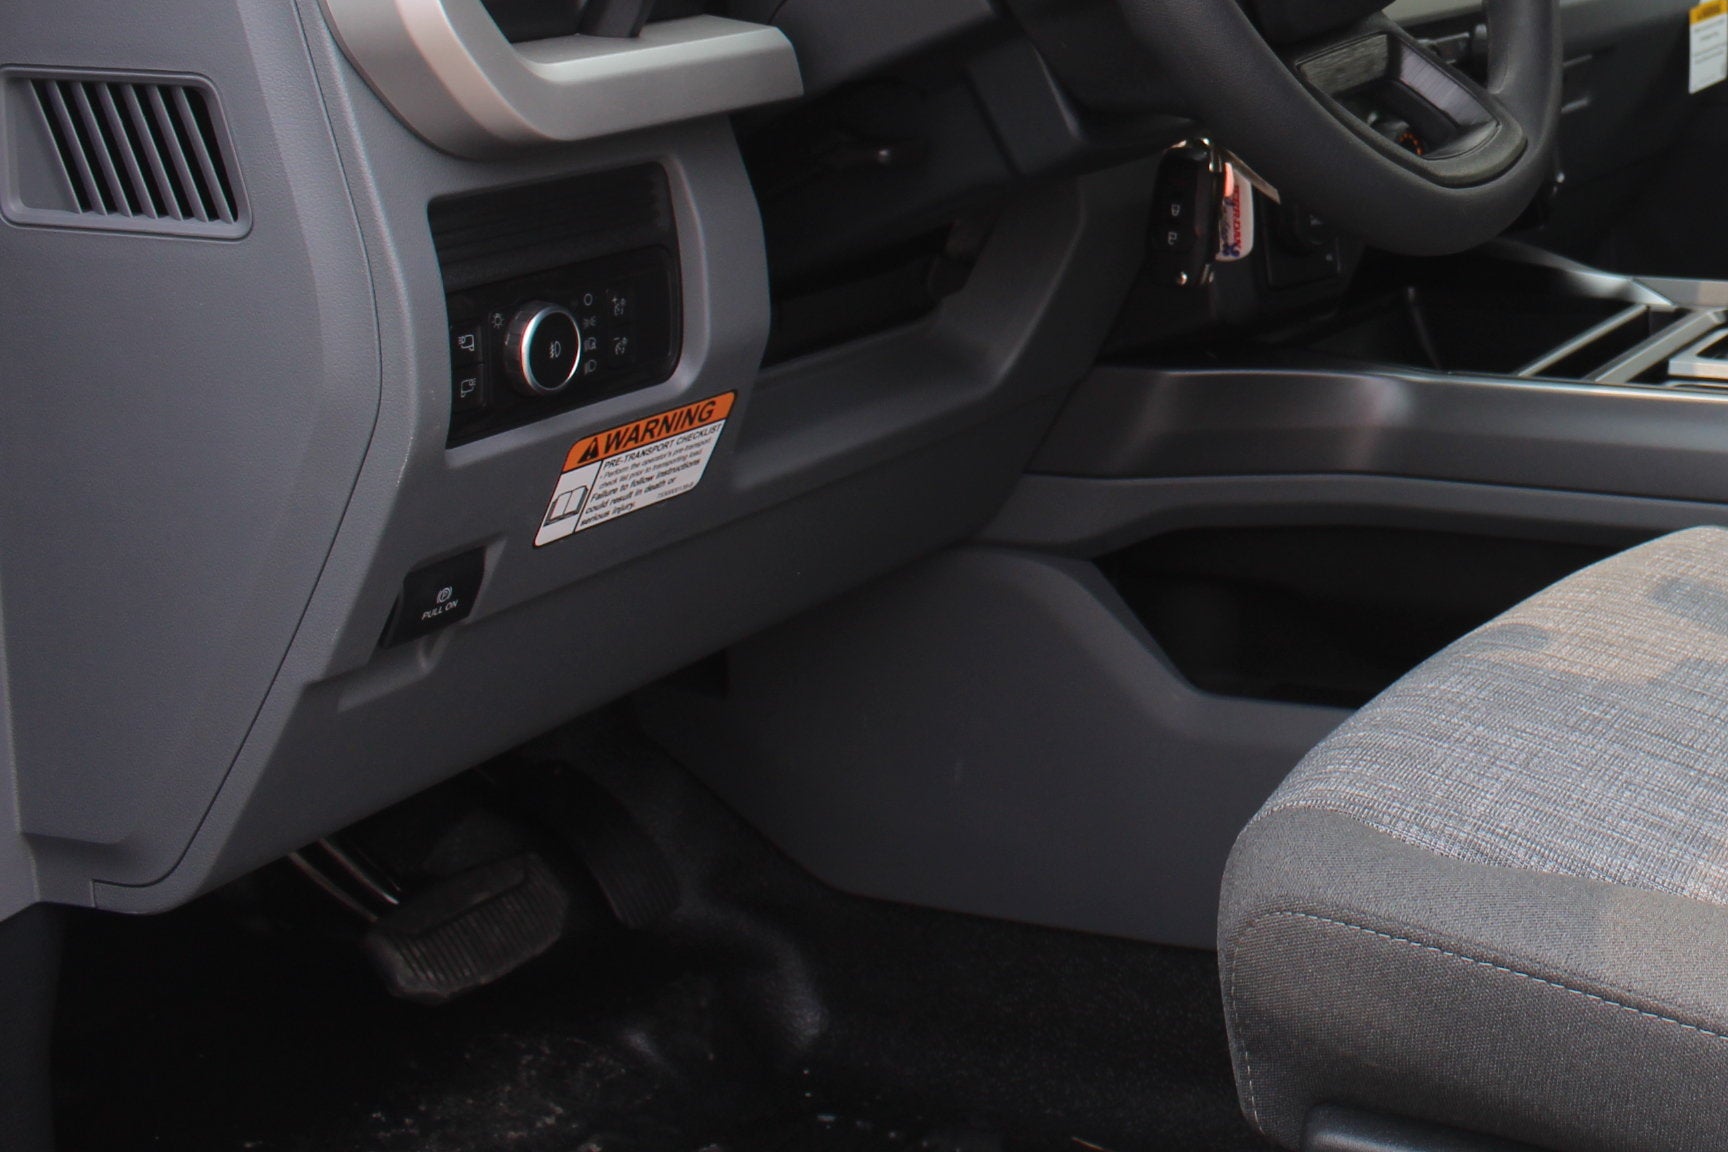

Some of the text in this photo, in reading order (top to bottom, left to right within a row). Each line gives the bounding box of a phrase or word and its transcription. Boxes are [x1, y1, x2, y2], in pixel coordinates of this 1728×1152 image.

[603, 401, 716, 454] WARNING
[603, 424, 722, 469] PRE-TRANSPORT CHECKLIST
[586, 503, 609, 514] could
[644, 481, 666, 493] death
[591, 488, 618, 501] Failure
[630, 475, 654, 490] follow
[656, 459, 700, 479] instructions
[580, 511, 610, 526] serious
[421, 599, 459, 621] PULL ON
